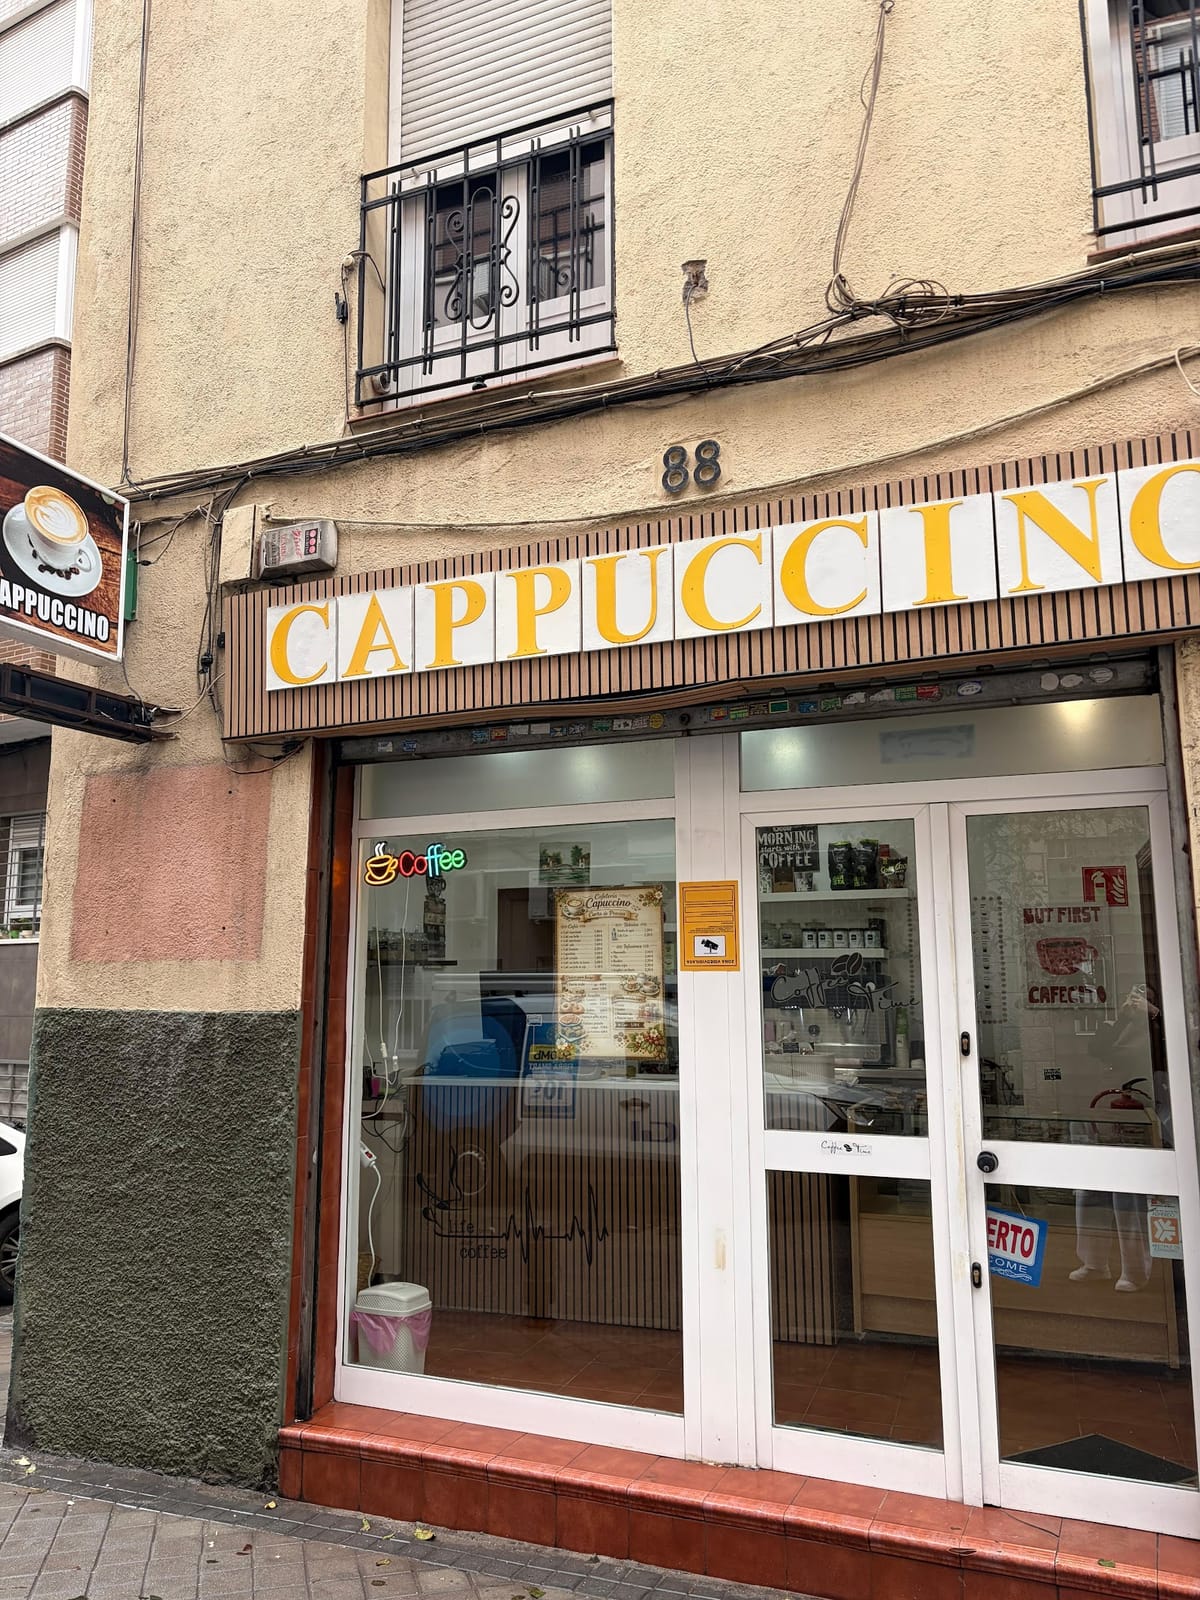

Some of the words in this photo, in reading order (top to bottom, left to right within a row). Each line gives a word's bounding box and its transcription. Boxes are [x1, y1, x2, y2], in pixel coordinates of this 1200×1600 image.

[661, 439, 721, 493] 88
[758, 829, 814, 845] MORNING
[783, 842, 801, 852] with
[398, 843, 467, 878] Coffee
[759, 851, 813, 869] COFFEE
[585, 897, 631, 910] Capuccino
[1023, 907, 1053, 925] BUT
[1057, 906, 1101, 923] FIRST
[770, 967, 849, 1009] Coffee
[847, 981, 921, 1013] Time
[820, 1140, 842, 1155] Coffee
[852, 1142, 871, 1154] Time
[448, 1218, 475, 1234] life
[459, 1244, 509, 1260] coffee
